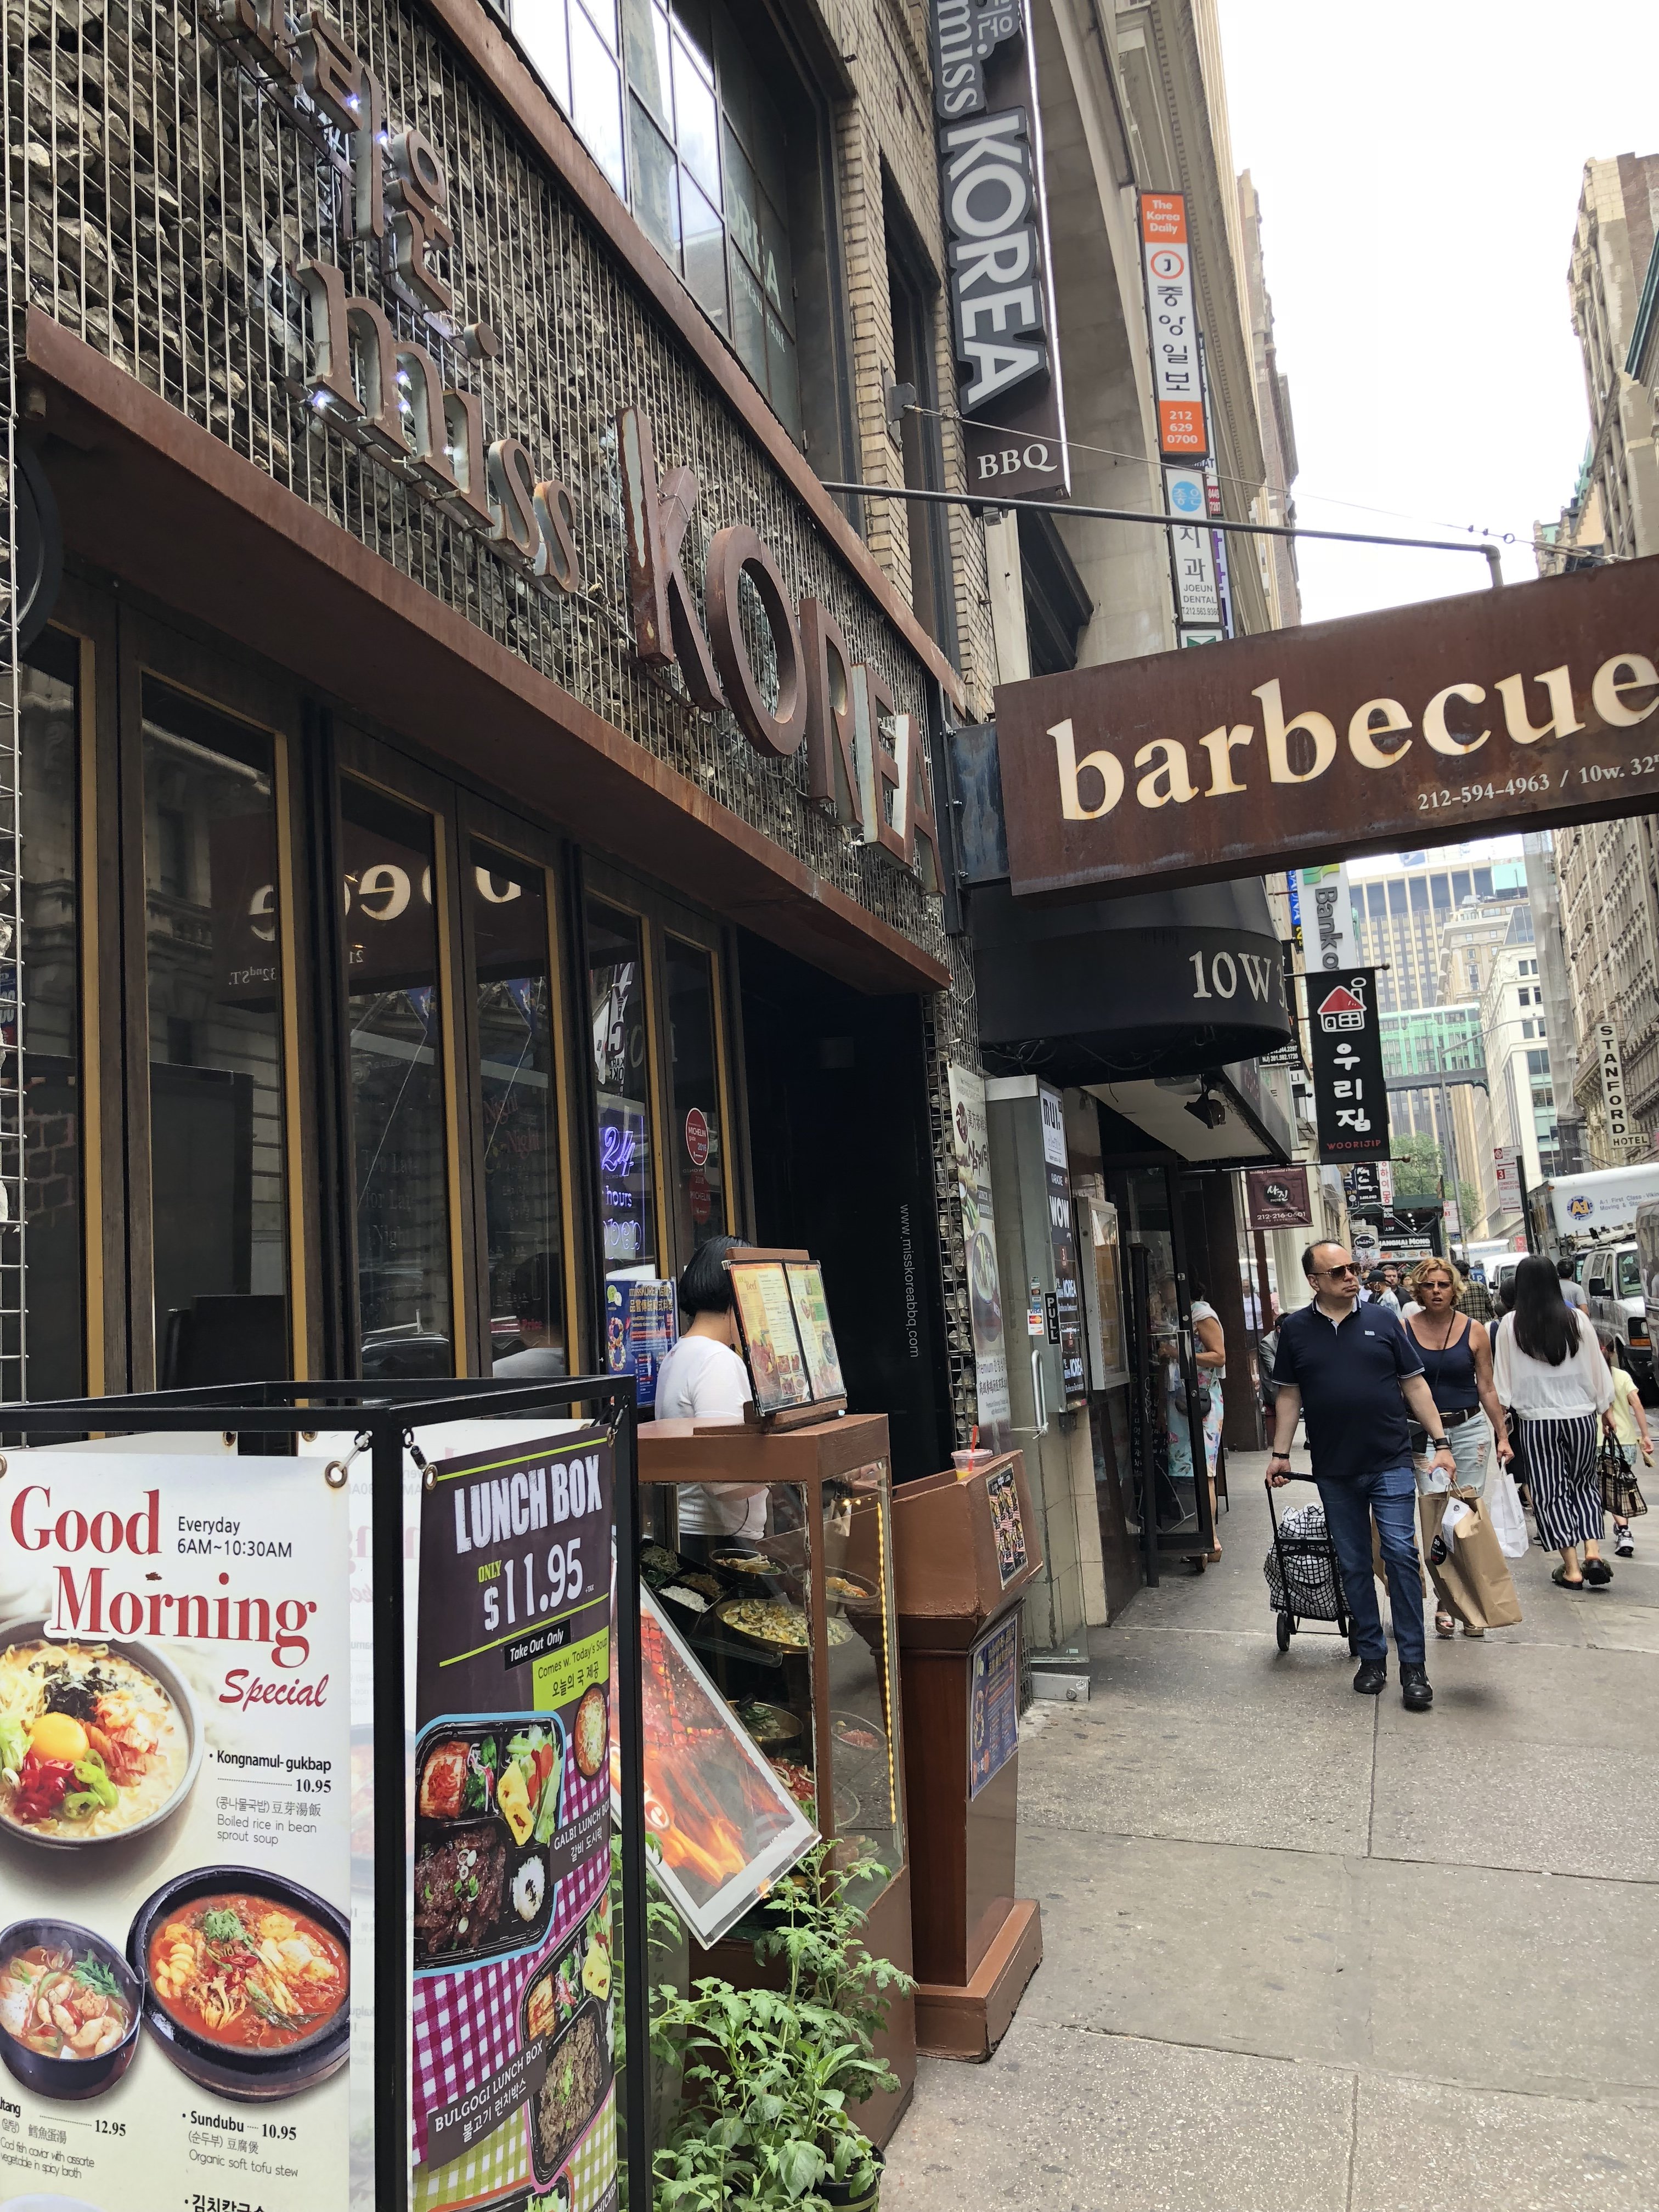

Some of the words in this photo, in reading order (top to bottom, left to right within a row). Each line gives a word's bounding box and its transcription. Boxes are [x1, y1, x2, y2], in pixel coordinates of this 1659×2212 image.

[938, 0, 988, 113] miss
[1147, 211, 1181, 222] Korea
[1152, 199, 1173, 210] The
[1149, 222, 1178, 235] Daily
[947, 114, 1040, 405] KOREA
[1158, 286, 1190, 392] 중앙일보
[297, 259, 579, 594] miss
[1169, 410, 1193, 421] 212
[1170, 423, 1193, 433] 629
[1167, 435, 1198, 445] 0700
[977, 443, 1058, 480] BBQ
[1173, 487, 1202, 506] 좋은
[1183, 595, 1217, 604] DENTAL
[1184, 584, 1213, 592] JOEUN
[616, 407, 945, 896] KOREA
[1047, 653, 1659, 821] barbecue
[1417, 774, 1550, 810] 212-594-4963
[1578, 764, 1625, 785] 10w.
[1315, 887, 1343, 951] Bank
[1189, 950, 1272, 1003] 10W
[1322, 952, 1340, 971] o
[1333, 1043, 1372, 1132] 우리집
[1599, 1025, 1626, 1135] STANFORD
[689, 1126, 707, 1138] MICHELIN
[1327, 1138, 1383, 1150] WOORIJIP
[1612, 1135, 1648, 1146] HOTEL
[601, 1126, 636, 1177] 24
[606, 1185, 632, 1208] hours
[690, 1190, 711, 1201] MICHELIN
[1267, 1185, 1289, 1201] 사진
[1049, 1195, 1070, 1229] WOW
[746, 1279, 757, 1290] Beef
[900, 1204, 919, 1358] www.misskoreabbq.com
[1047, 1296, 1058, 1340] PULL
[454, 1469, 548, 1554] LUNCH
[552, 1454, 603, 1526] BOX
[11, 1486, 162, 1555] Good
[178, 1516, 240, 1536] Everyday
[177, 1539, 292, 1558] 6AM~10:30AM
[478, 1560, 501, 1583] ONLY
[484, 1537, 583, 1632] $11.95
[50, 1565, 317, 1668] Morning
[510, 1644, 528, 1662] Take
[529, 1639, 544, 1655] Out
[546, 1628, 564, 1647] Only
[538, 1661, 562, 1680] Comes
[562, 1656, 571, 1669] w.
[572, 1644, 596, 1665] Today's
[596, 1637, 608, 1655] Soup
[219, 1668, 330, 1712] Special
[551, 1674, 575, 1698] 오늘의
[576, 1669, 585, 1686] 국
[586, 1661, 600, 1680] 제공
[296, 1779, 332, 1793] 10.95
[217, 1814, 249, 1827] Boiled
[253, 1819, 271, 1830] rice
[275, 1821, 284, 1831] in
[288, 1821, 317, 1833] bean
[217, 1831, 249, 1842] sprout
[253, 1835, 279, 1847] soup
[554, 1826, 577, 1850] GALBI
[578, 1812, 600, 1836] LUNCH
[600, 1801, 611, 1818] BOX
[570, 1844, 584, 1864] 갈비
[585, 1827, 603, 1855] 도시락
[435, 2087, 492, 2132] BULGOGI
[493, 2059, 525, 2097] LUNCH
[526, 2038, 544, 2069] BOX
[462, 2108, 493, 2143] 불고기
[494, 2076, 527, 2118] 런치박스
[95, 2119, 126, 2136] 12.95
[190, 2111, 245, 2132] Sundubu
[262, 2124, 297, 2141] 10.95
[1, 2136, 14, 2151] Cod
[16, 2141, 27, 2154] fish
[29, 2147, 49, 2159] caviar
[51, 2151, 65, 2162] with
[67, 2155, 95, 2168] assorte
[188, 2130, 223, 2148] (순두부)
[227, 2137, 259, 2155] 豆腐煲
[1, 2151, 32, 2169] vegetable
[34, 2160, 40, 2170] in
[42, 2162, 60, 2176] spicy
[62, 2165, 83, 2179] broth
[189, 2148, 225, 2166] Organic
[228, 2157, 247, 2170] soft
[251, 2160, 272, 2175] tofu
[275, 2164, 298, 2177] stew
